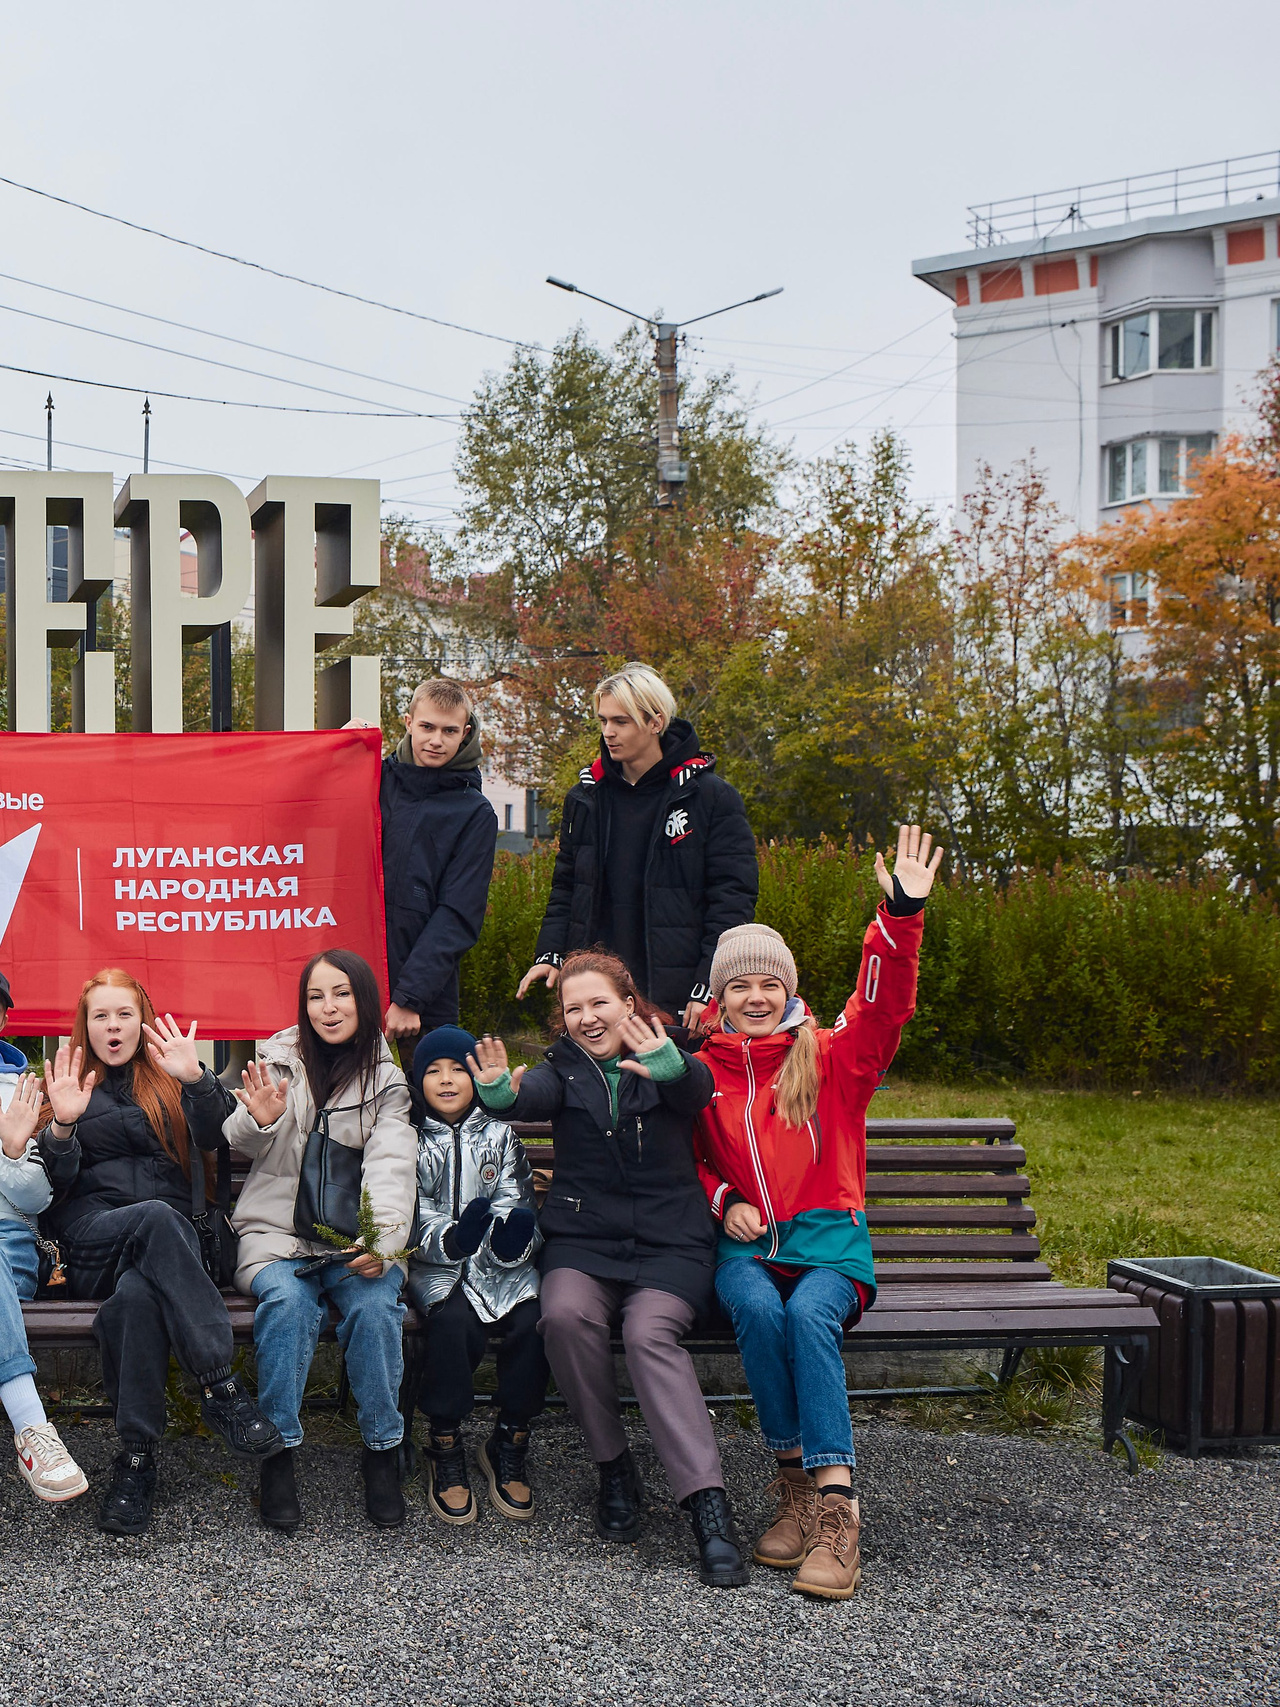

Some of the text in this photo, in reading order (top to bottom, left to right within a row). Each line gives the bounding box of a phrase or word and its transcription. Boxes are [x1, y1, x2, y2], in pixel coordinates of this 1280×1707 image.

[112, 843, 304, 868] ЛУГАНСКАЯ
[115, 876, 299, 903] НАРОДНАЯ
[116, 907, 338, 932] РЕСПУБЛИКА
